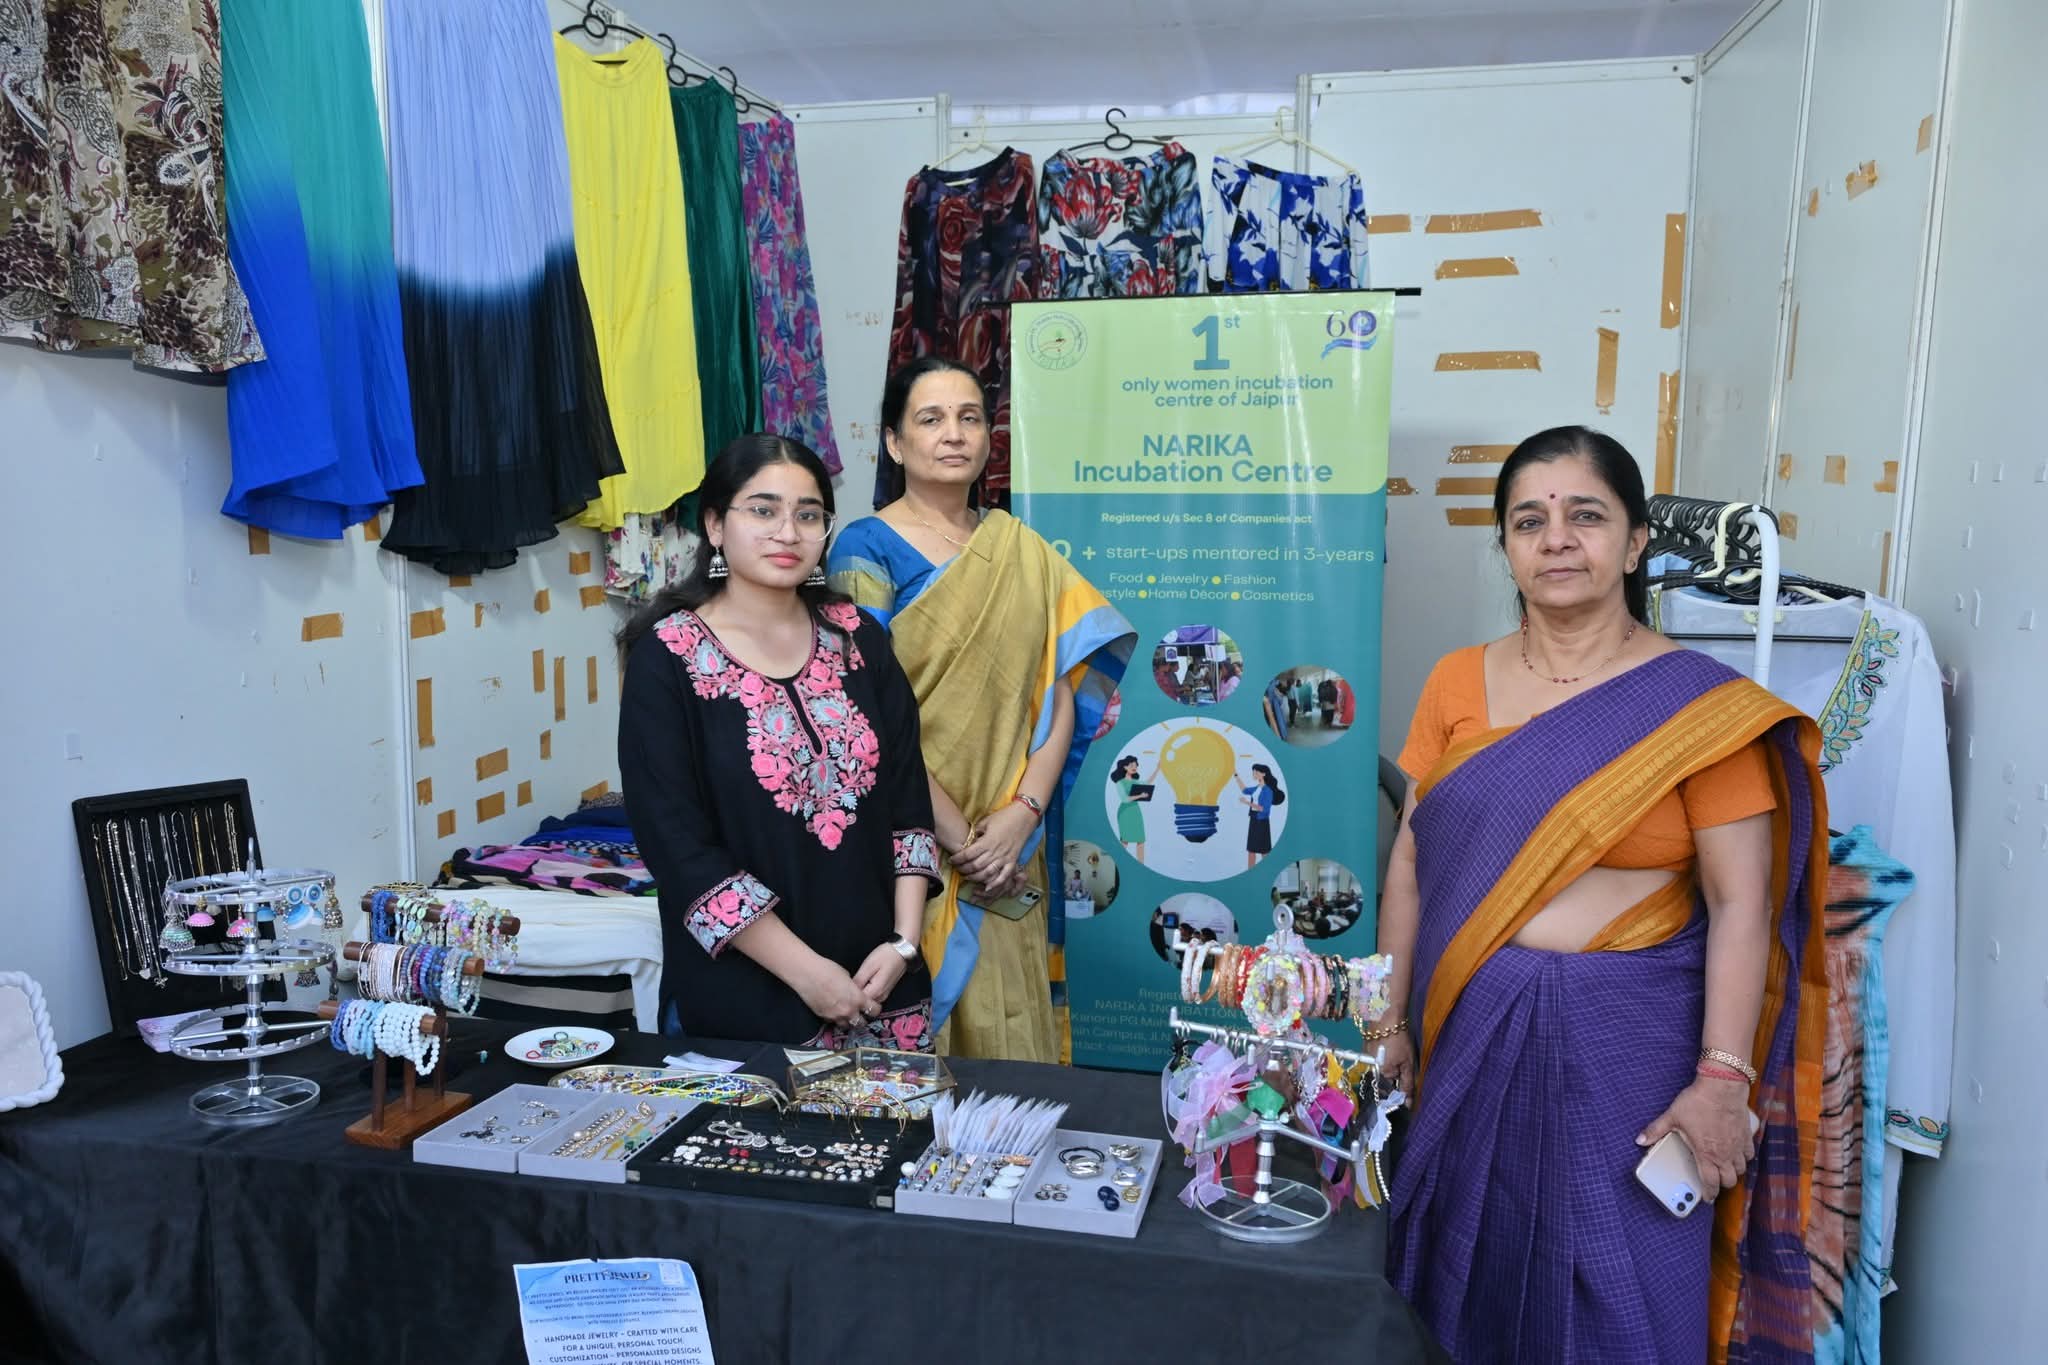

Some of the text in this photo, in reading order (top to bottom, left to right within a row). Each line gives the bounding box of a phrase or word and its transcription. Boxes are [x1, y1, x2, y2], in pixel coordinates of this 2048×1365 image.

[1122, 375, 1333, 394] only women incubation
[1155, 391, 1298, 408] centre of Jaipur
[1143, 434, 1253, 457] NARIKA
[1074, 459, 1333, 483] Incubation Centre
[1101, 513, 1313, 525] Registered u/s Sec 8 of Companies act
[1106, 546, 1188, 562] start-ups
[1192, 546, 1279, 560] mentored
[1284, 547, 1299, 561] in
[1303, 547, 1375, 565] 3-years
[1109, 572, 1276, 585] Food Jewelry Fashion
[1101, 587, 1136, 601] style
[1148, 588, 1187, 600] Home
[1242, 590, 1314, 601] Cosmetics
[1095, 1000, 1146, 1012] NARIKA
[544, 1333, 585, 1343] HANDMADE
[588, 1331, 618, 1340] JEWELRY
[627, 1328, 657, 1337] CRAFTED
[660, 1327, 678, 1335] WITH
[680, 1326, 698, 1334] CARE
[617, 1340, 655, 1349] PERSONAL
[549, 1353, 608, 1363] CUSTOMIZATION
[616, 1349, 669, 1359] PERSONALIZED
[671, 1347, 701, 1355] DESIGNS
